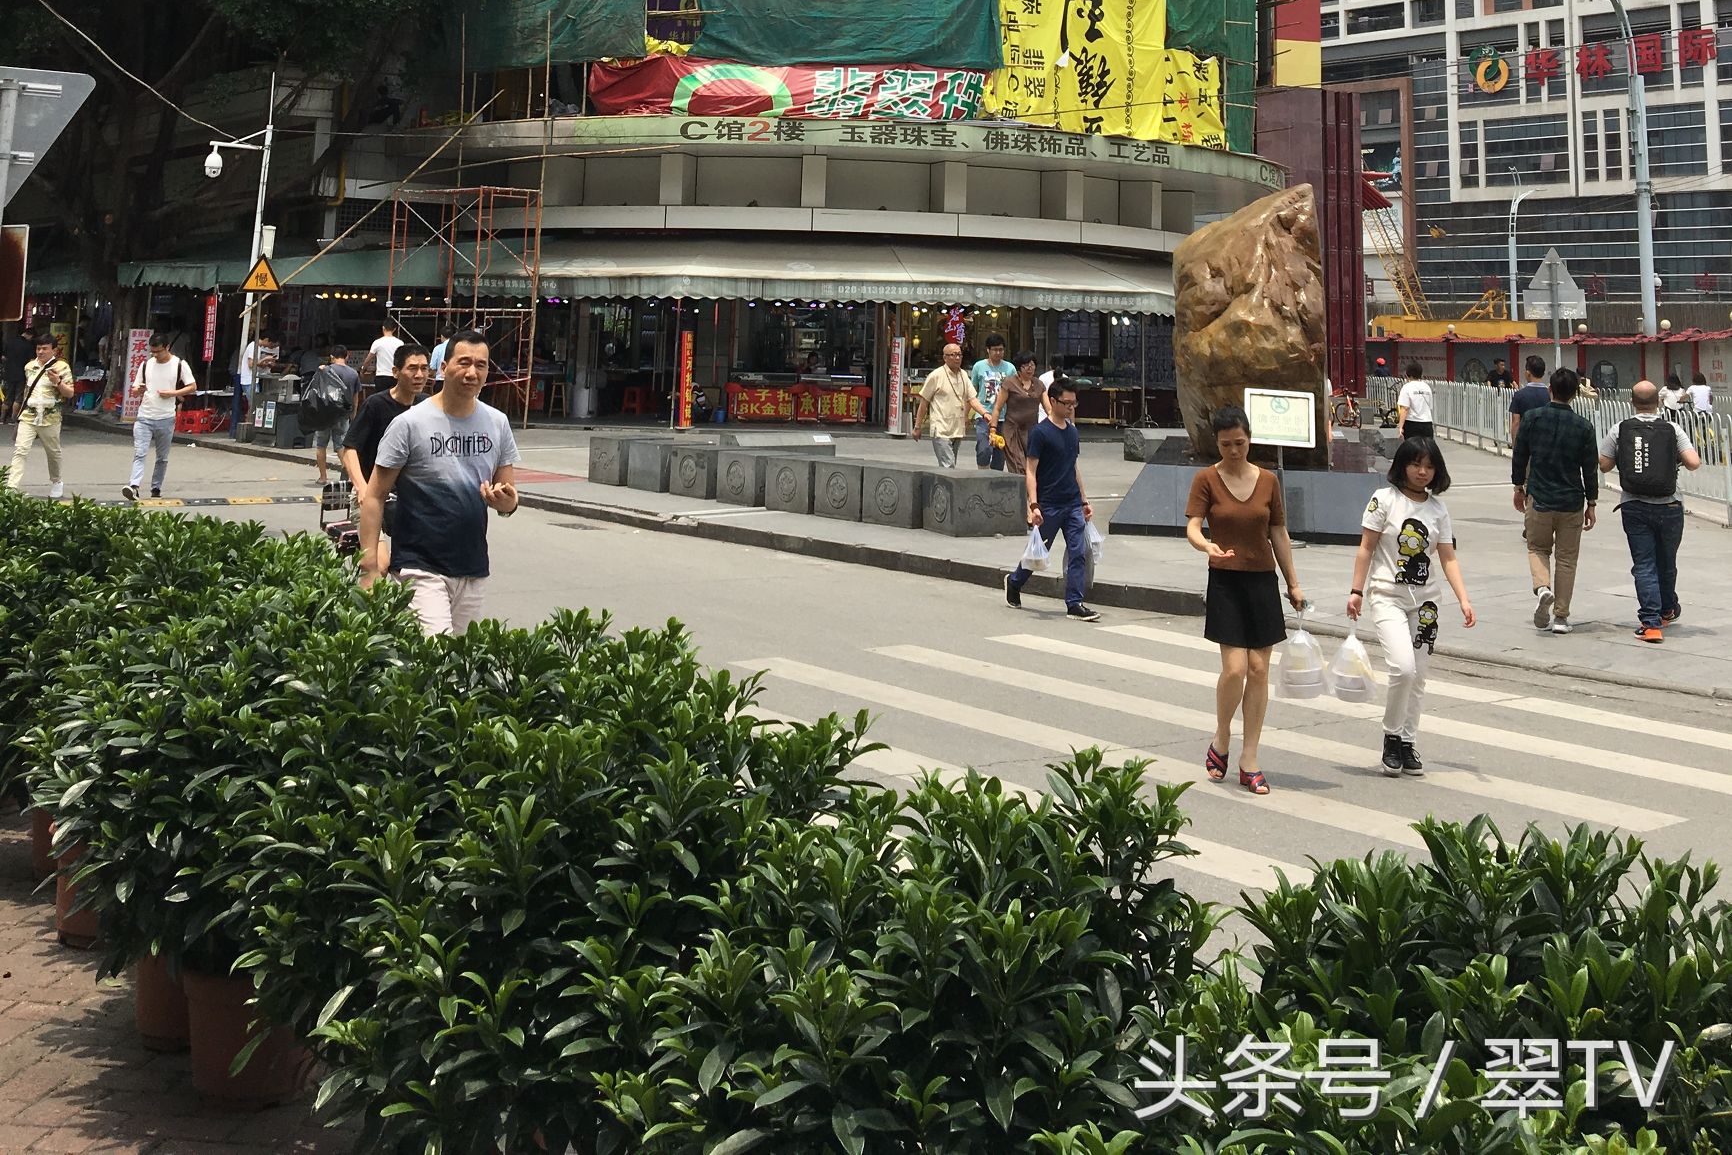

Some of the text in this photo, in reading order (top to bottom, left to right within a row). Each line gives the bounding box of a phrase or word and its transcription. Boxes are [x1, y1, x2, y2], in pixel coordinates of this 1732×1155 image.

[1525, 28, 1717, 86] 华林国际
[680, 119, 805, 143] C馆2楼
[255, 272, 268, 287] 慢
[1635, 450, 1643, 473] LESSO
